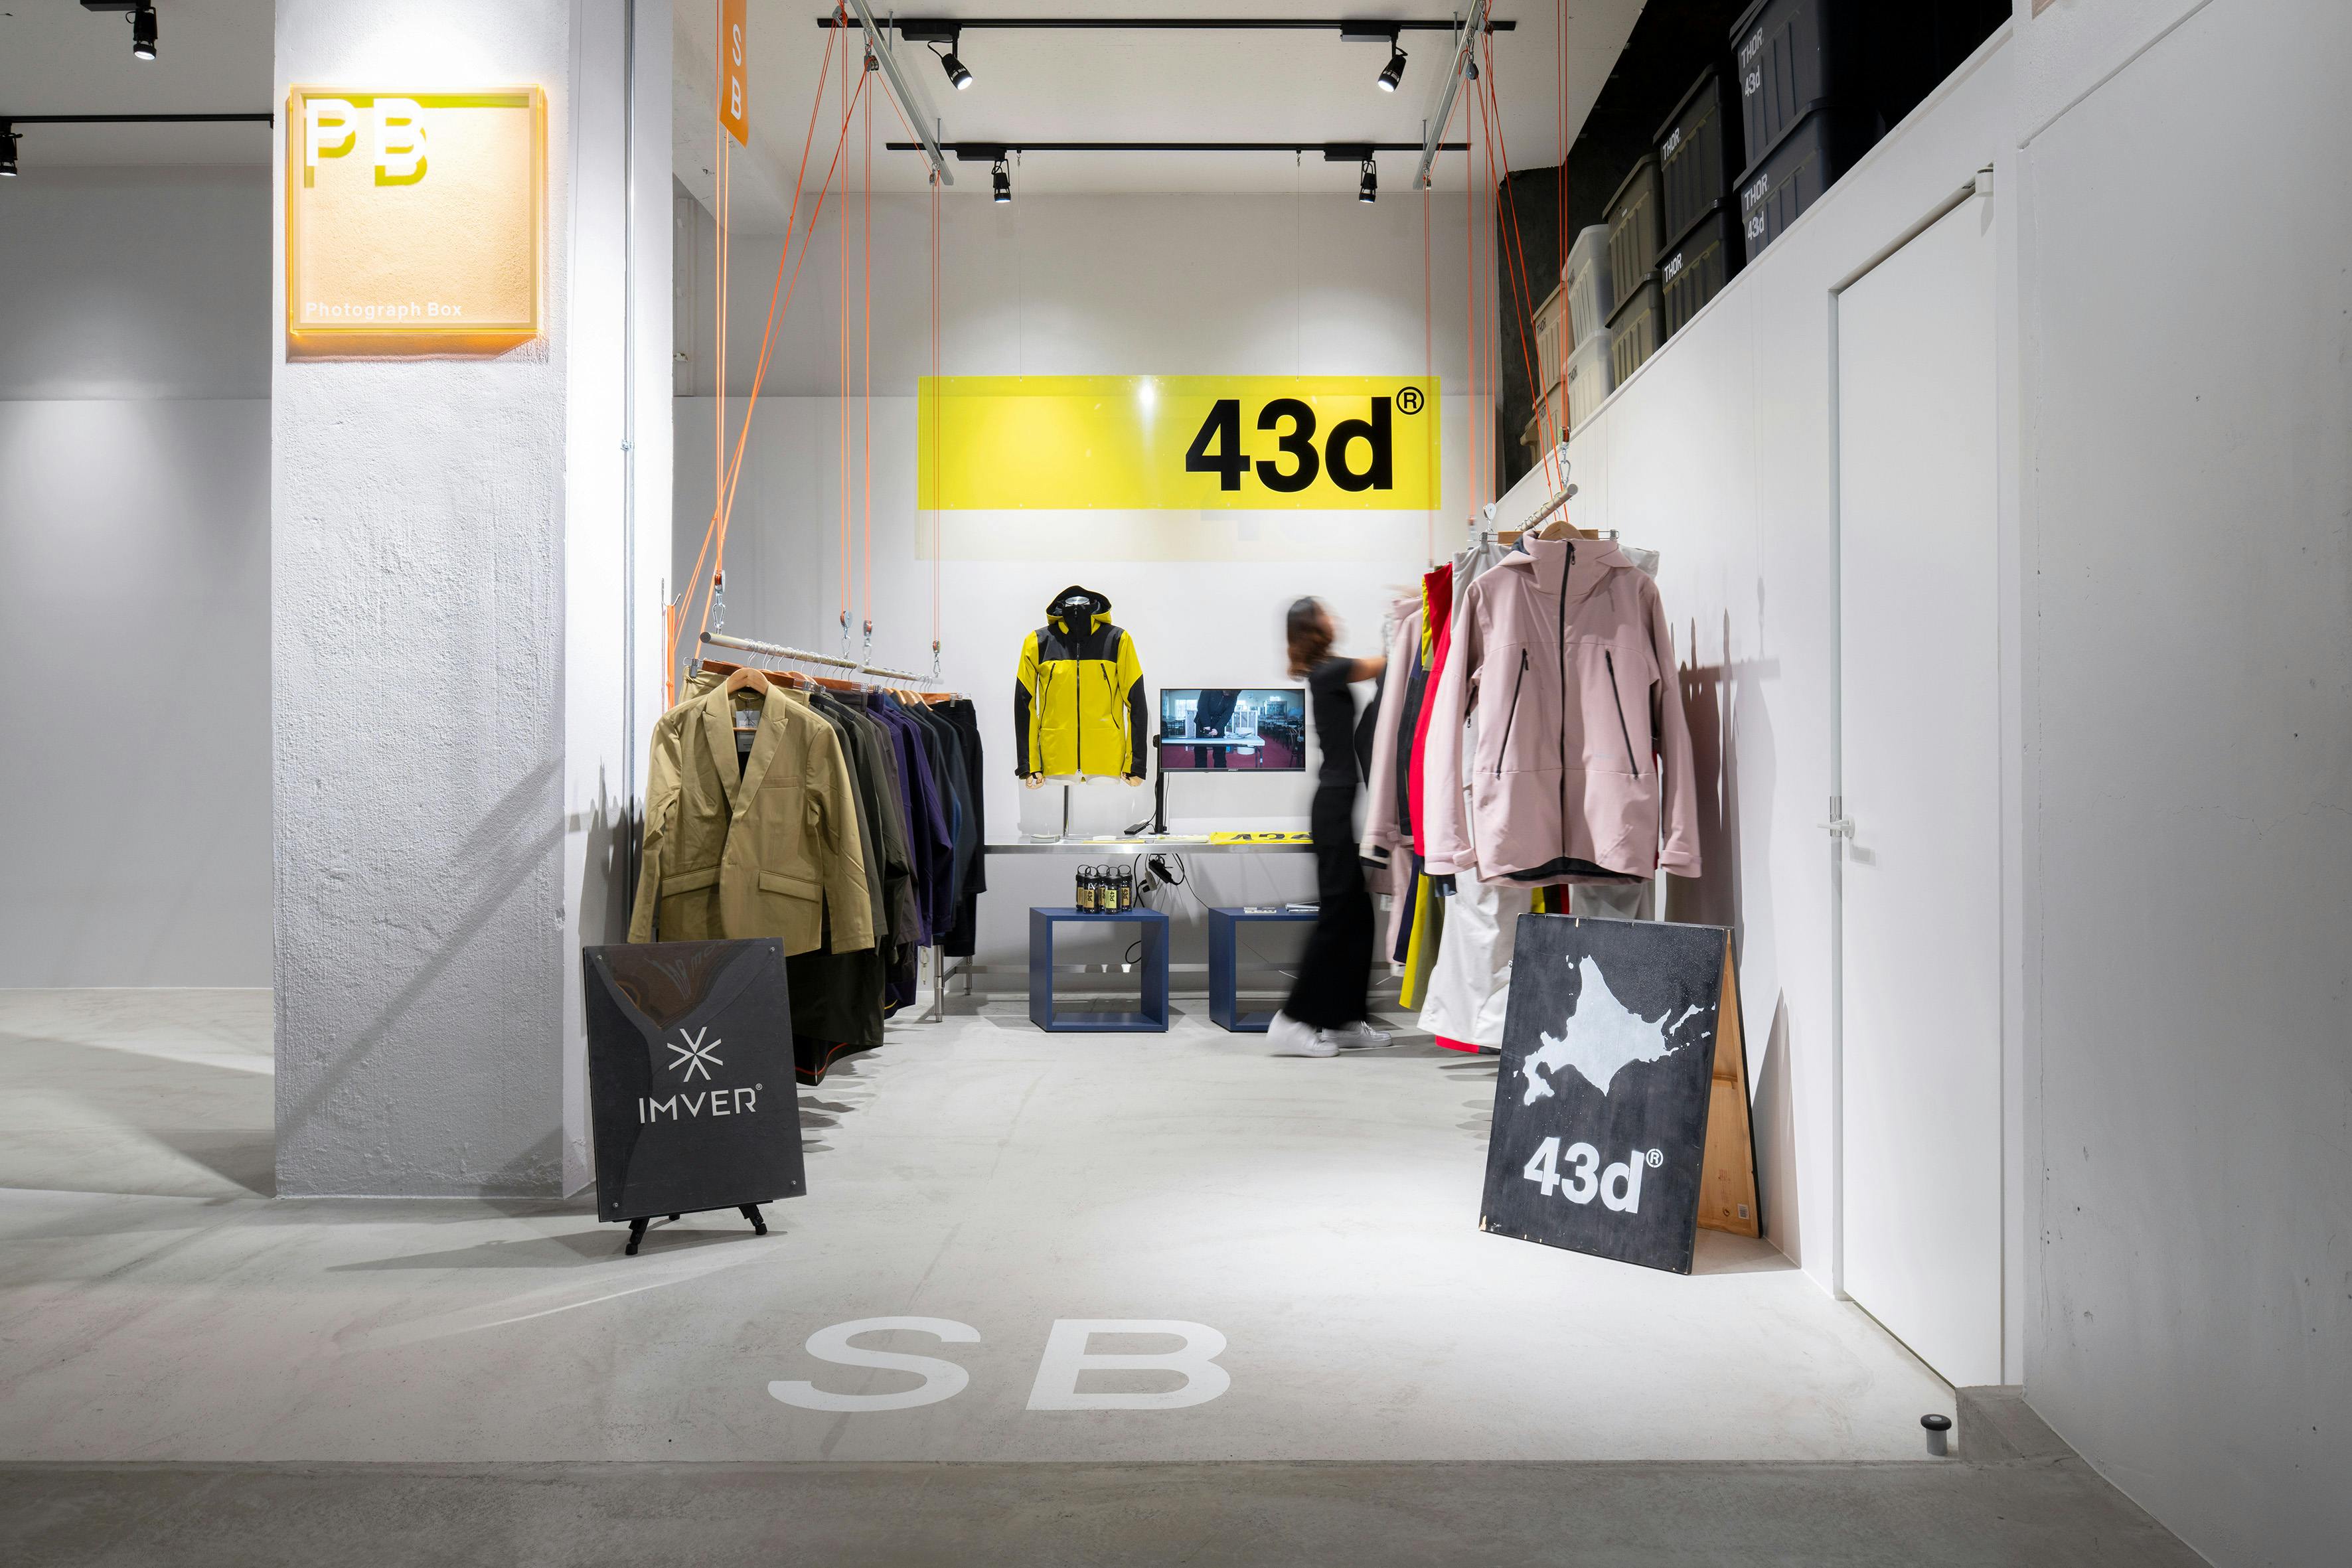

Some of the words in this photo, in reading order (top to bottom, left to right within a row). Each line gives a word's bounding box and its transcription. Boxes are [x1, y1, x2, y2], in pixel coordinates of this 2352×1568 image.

[1741, 27, 1763, 68] THOR
[1745, 65, 1760, 97] 43d
[1663, 127, 1680, 161] THOR
[1745, 173, 1767, 210] THOR
[1748, 211, 1764, 240] 43d
[1664, 253, 1682, 283] THOR
[305, 302, 421, 319] Photograph
[428, 303, 461, 316] Box
